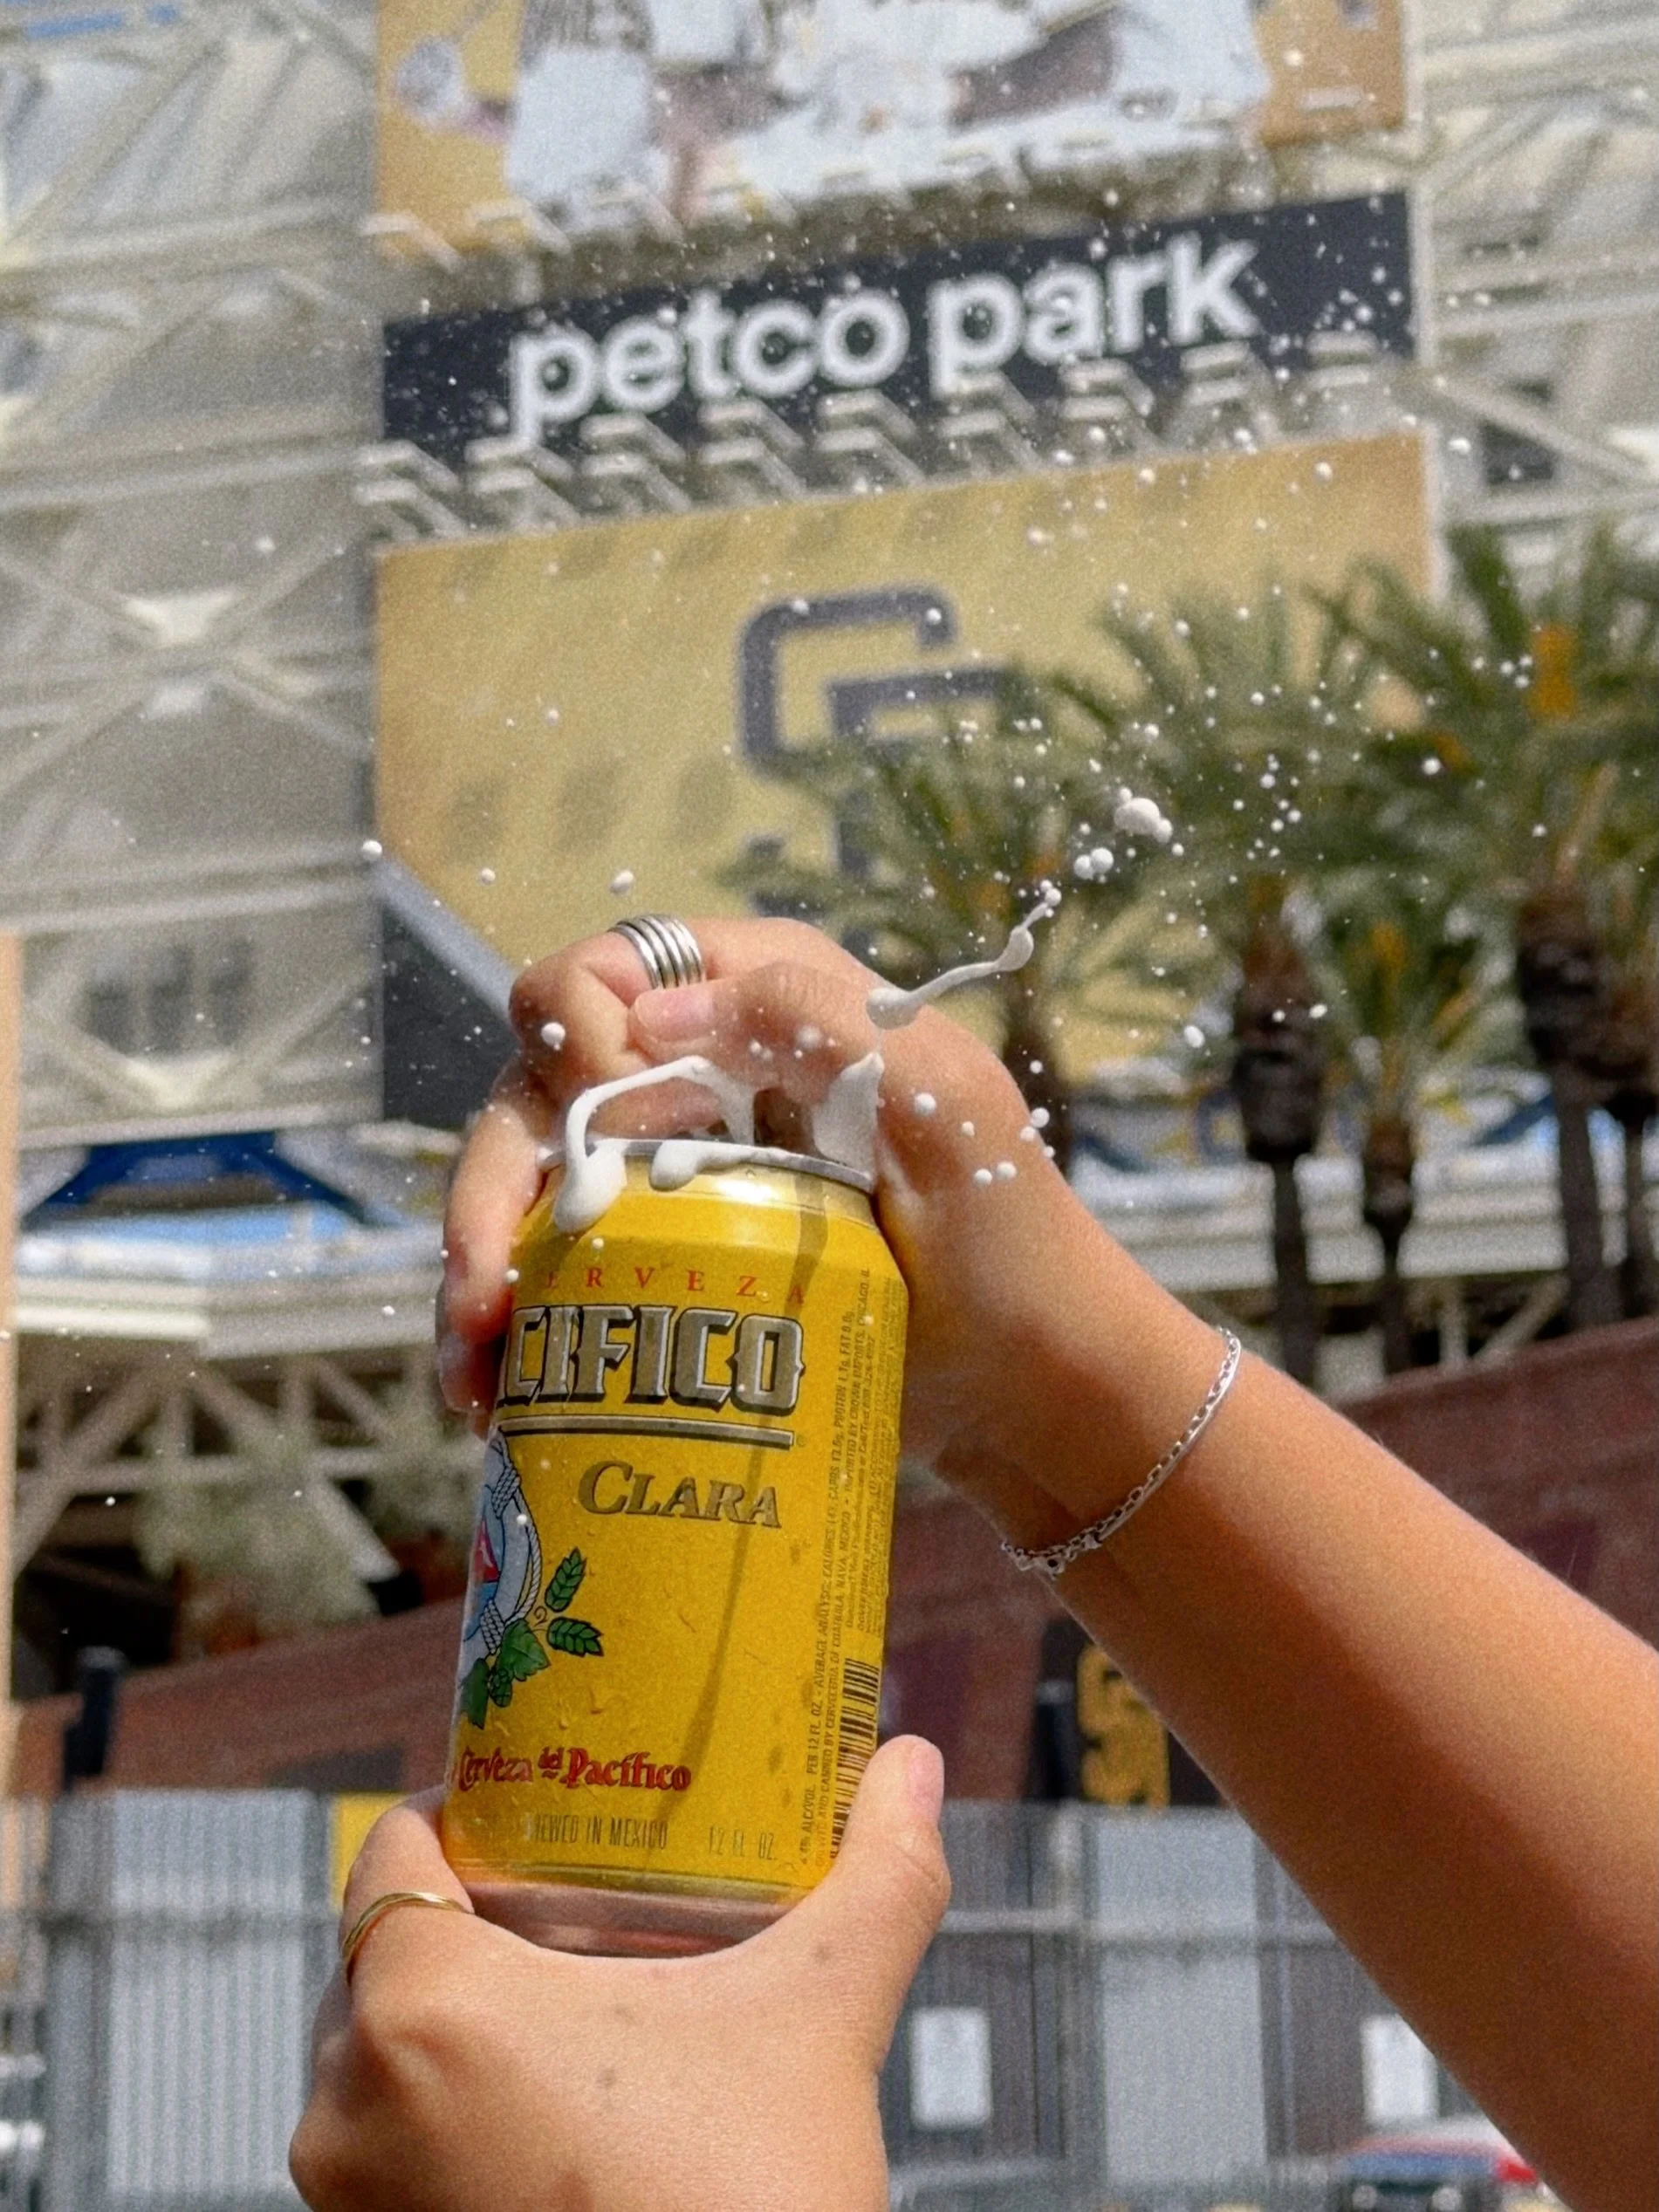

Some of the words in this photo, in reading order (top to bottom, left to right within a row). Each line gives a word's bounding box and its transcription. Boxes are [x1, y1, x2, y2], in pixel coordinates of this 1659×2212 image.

[511, 288, 909, 445] petco
[927, 232, 1258, 398] park
[545, 1266, 805, 1305] ERVEZA
[840, 1333, 851, 1355] FAT
[833, 1384, 847, 1428] PROTEIN
[848, 1422, 858, 1436] BY
[813, 1639, 827, 1687] AVERAGE
[807, 1736, 819, 1750] 12
[824, 1731, 833, 1746] BY
[457, 1745, 534, 1791] Cerveza
[806, 1754, 818, 1774] PER
[820, 1749, 833, 1791] CANNED
[819, 1795, 828, 1818] AND
[586, 1816, 603, 1846] IN
[609, 1817, 668, 1850] MEXICO
